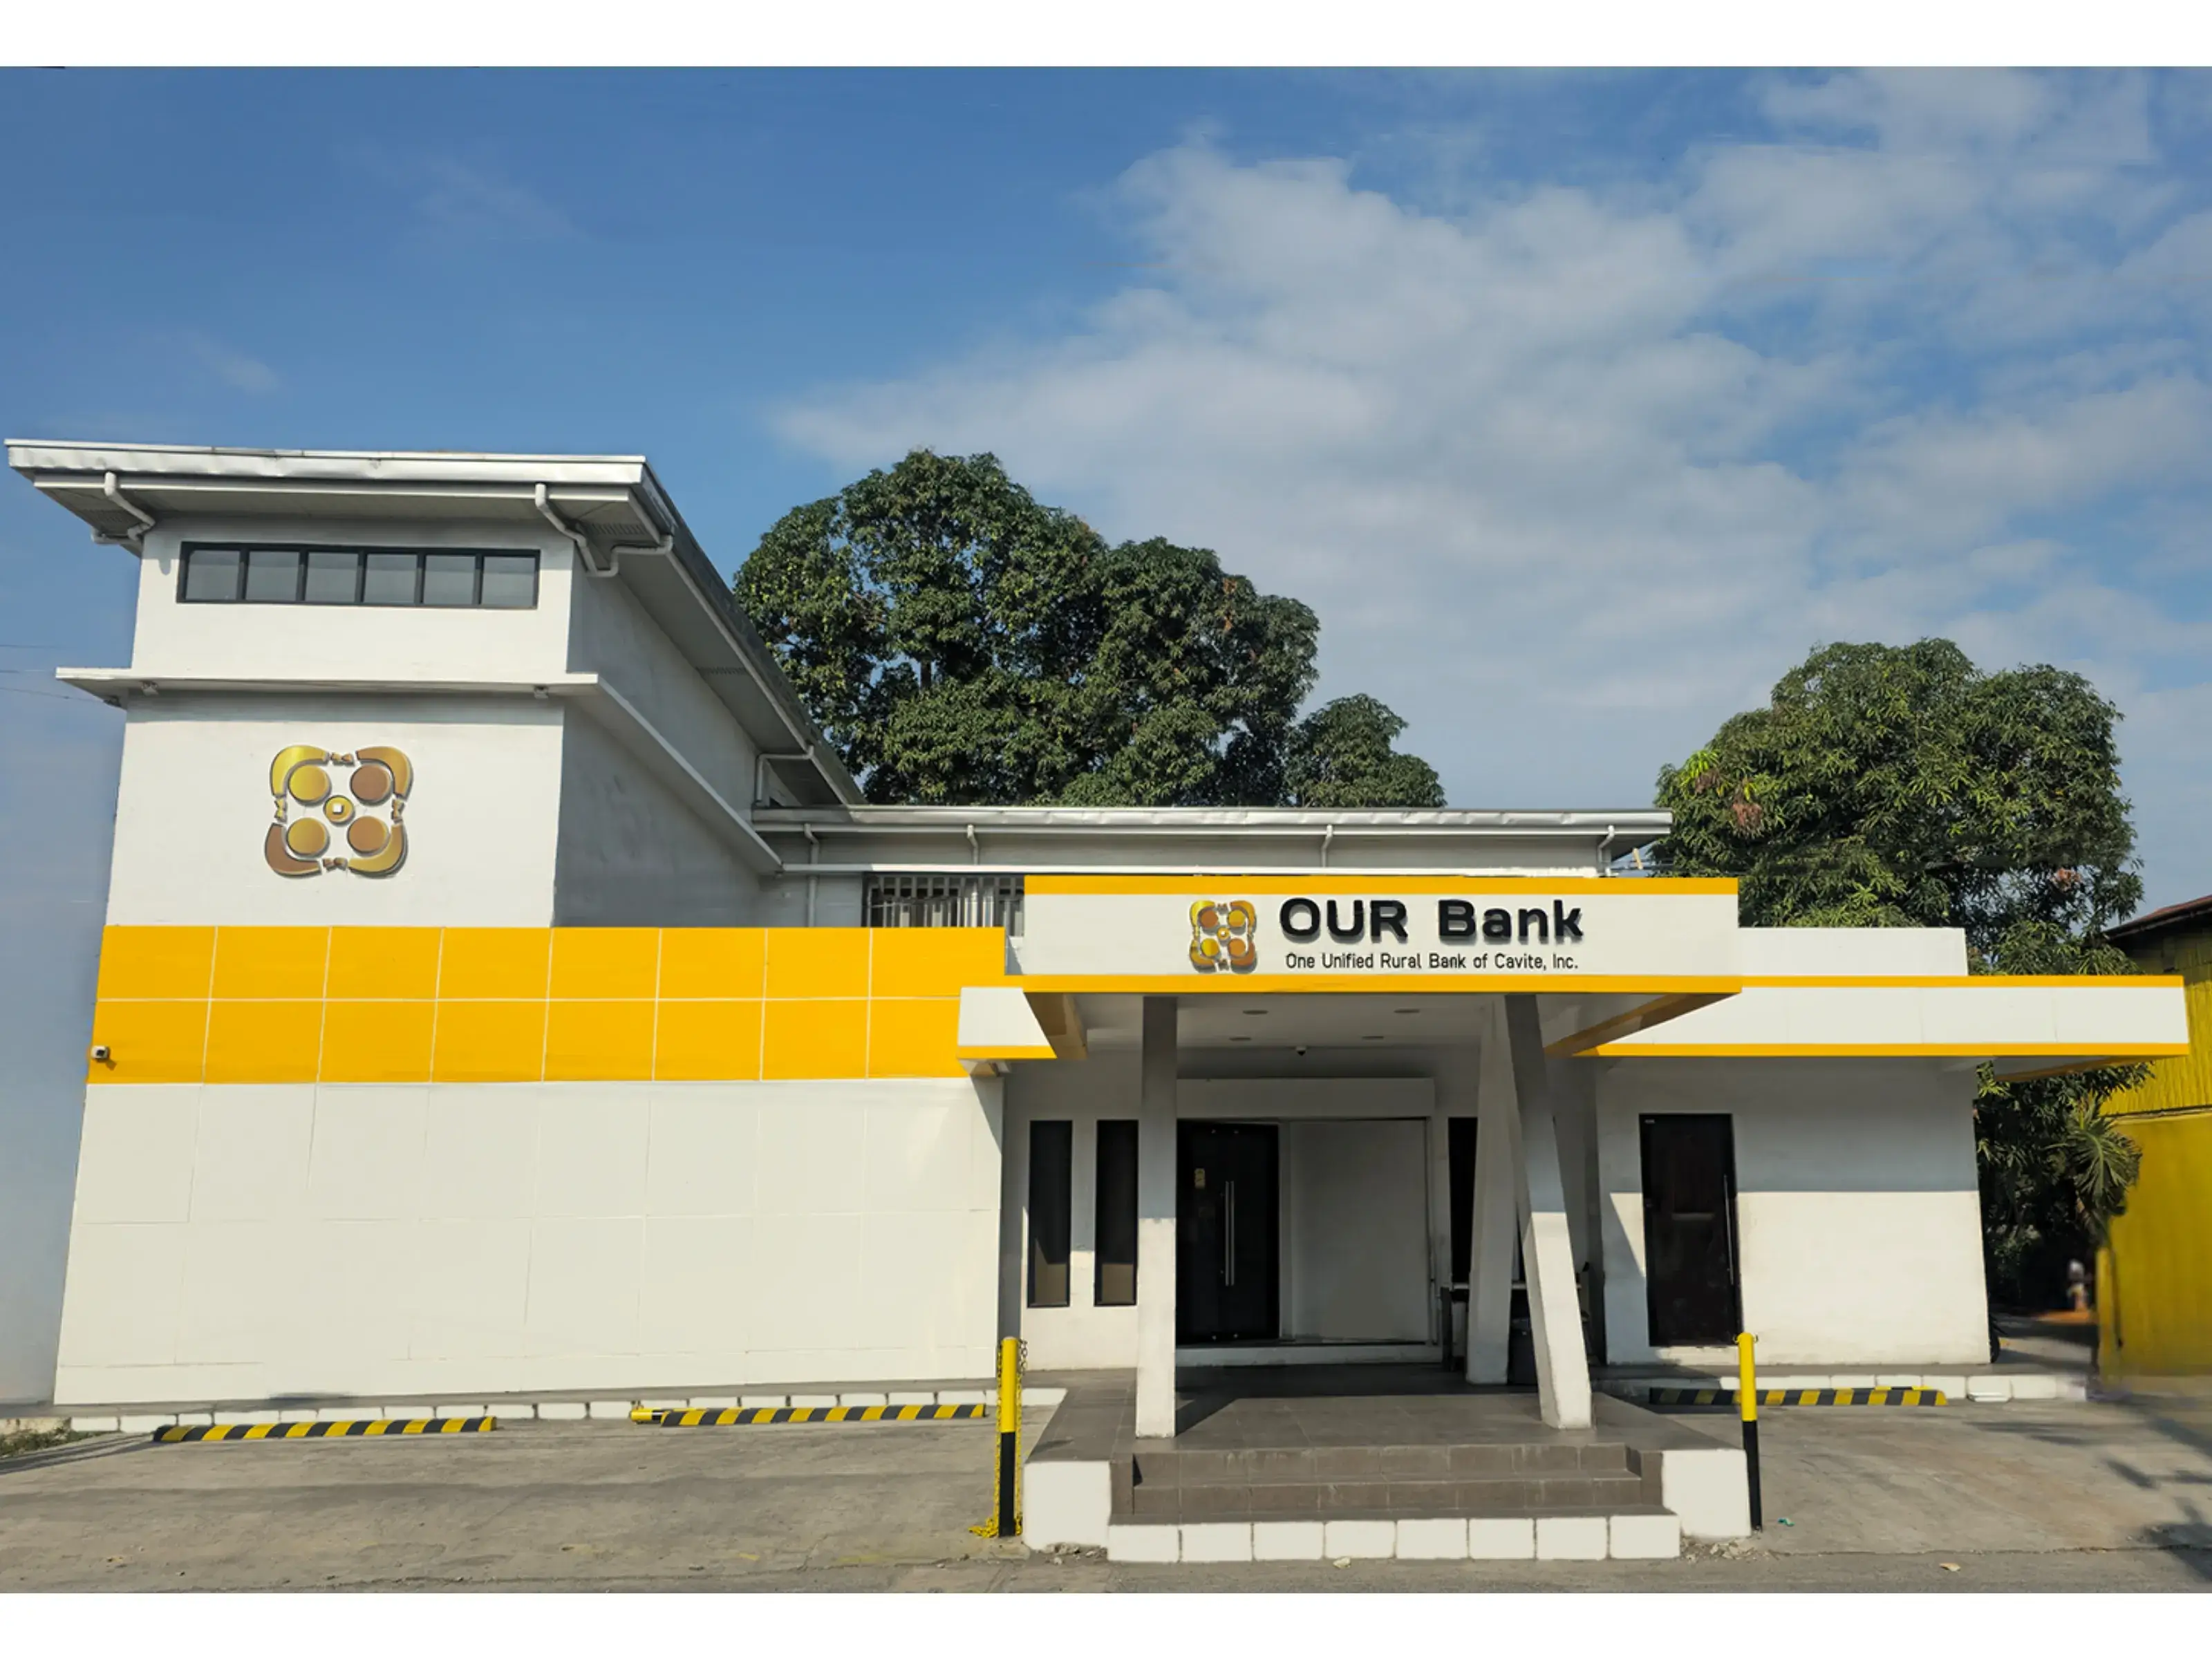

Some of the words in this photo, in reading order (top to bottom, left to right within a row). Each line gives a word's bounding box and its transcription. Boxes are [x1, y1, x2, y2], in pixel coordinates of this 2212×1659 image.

[1280, 898, 1408, 939] OUR
[1438, 899, 1583, 939] Bank
[1286, 953, 1315, 968] One
[1322, 953, 1374, 968] Unified
[1380, 953, 1421, 968] Rural
[1429, 953, 1466, 968] Bank
[1473, 953, 1488, 968] of
[1494, 953, 1546, 971] Cavite,
[1553, 954, 1578, 969] Inc.
